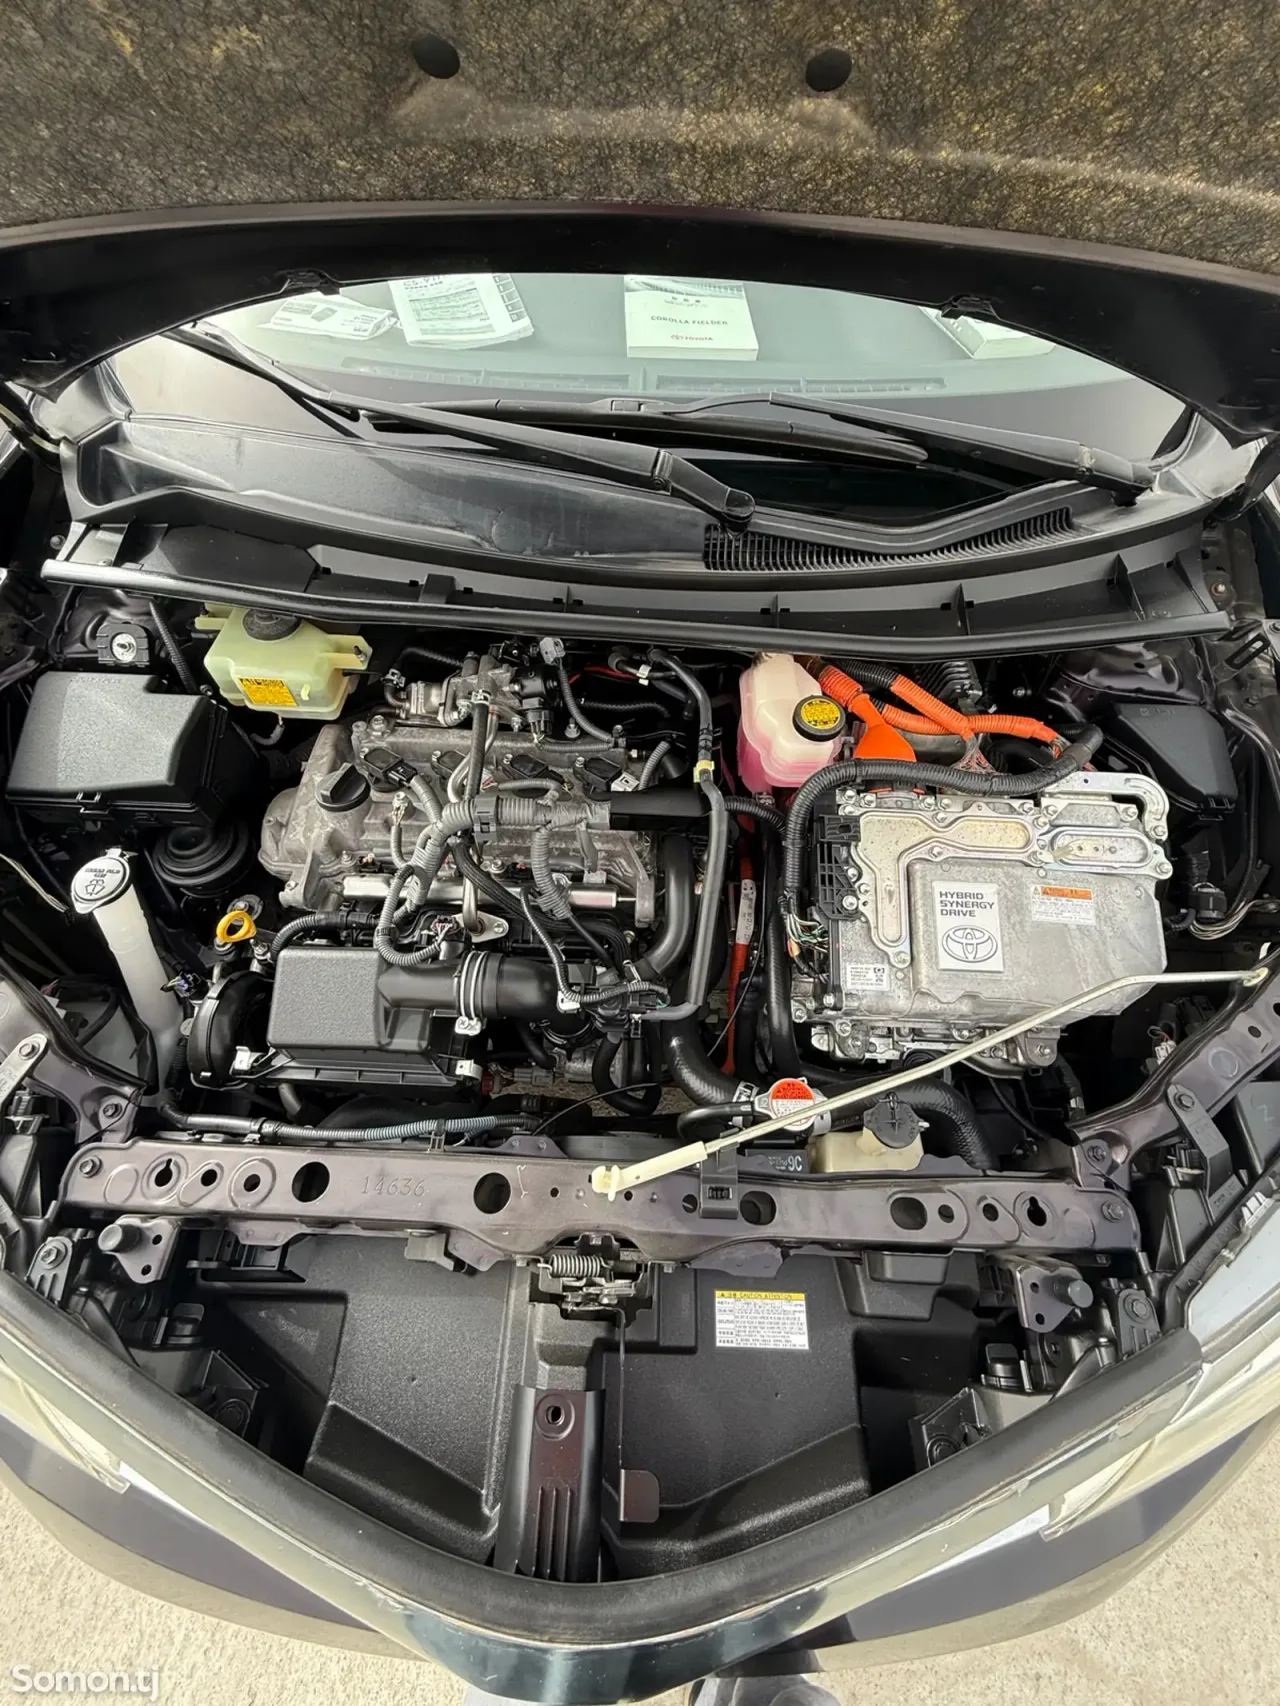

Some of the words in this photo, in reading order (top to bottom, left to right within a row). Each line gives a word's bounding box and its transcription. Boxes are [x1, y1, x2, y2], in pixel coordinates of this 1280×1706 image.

[650, 315, 690, 325] COROLLA
[939, 890, 984, 900] HYBRID
[940, 900, 995, 910] SYNERGY
[940, 908, 977, 917] DRIVE
[787, 1155, 803, 1171] 9C
[361, 1176, 425, 1196] 14636
